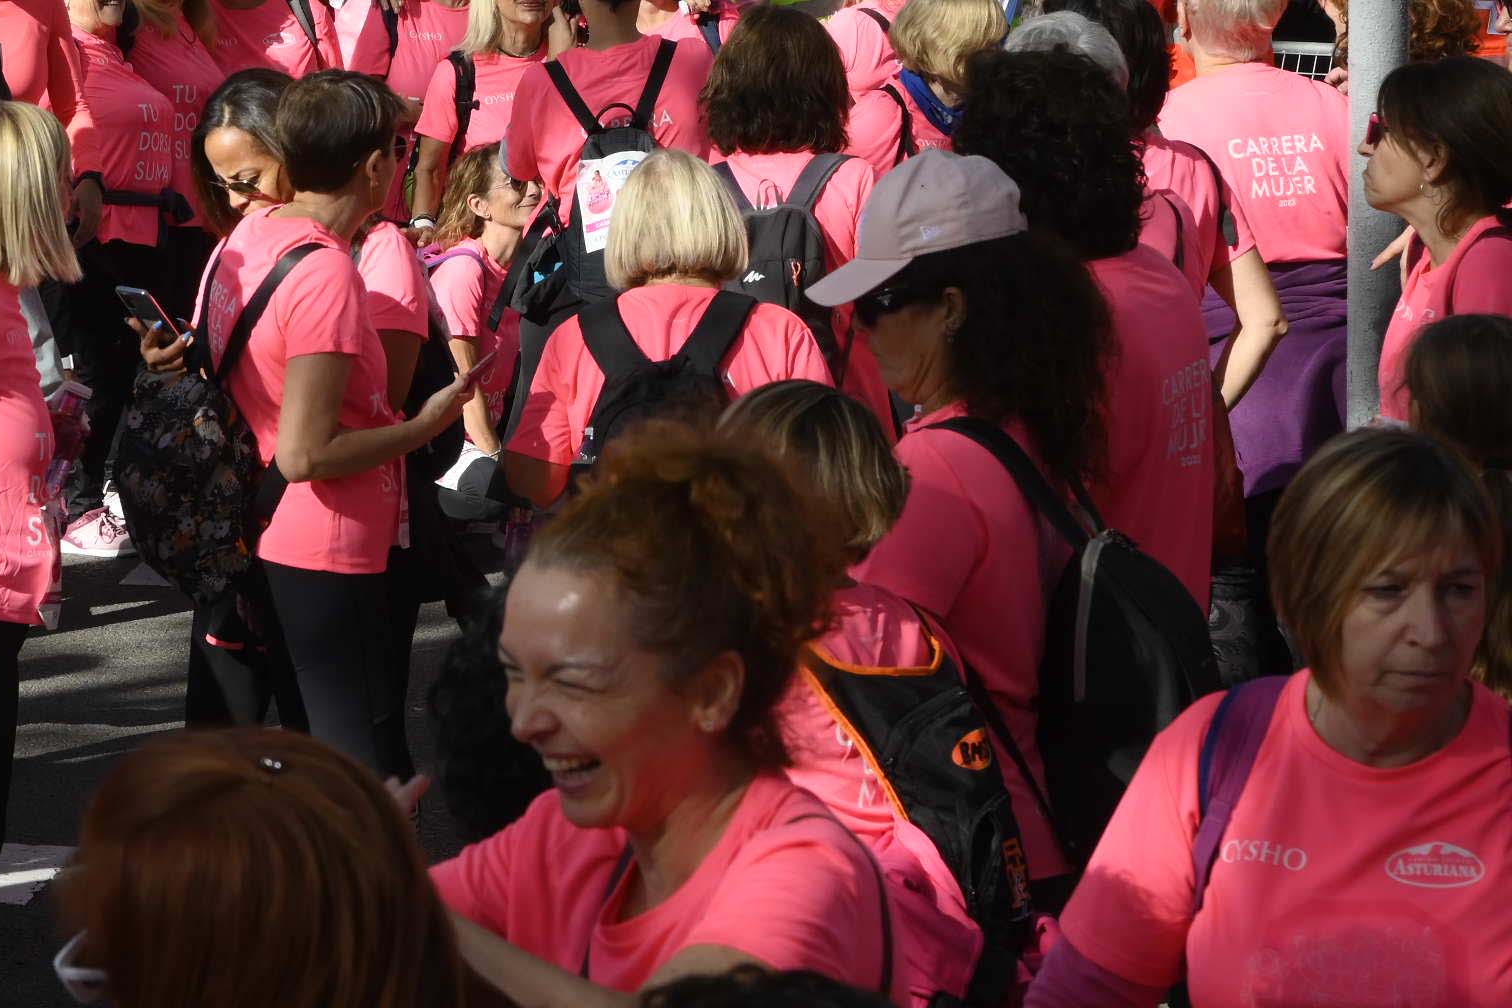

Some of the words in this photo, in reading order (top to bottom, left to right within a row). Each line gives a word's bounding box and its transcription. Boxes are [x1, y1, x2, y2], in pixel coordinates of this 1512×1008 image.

[409, 31, 442, 41] OYSHO
[172, 84, 197, 104] TU
[138, 103, 159, 123] TU
[1228, 132, 1325, 159] CARRERA
[135, 160, 169, 182] SUMA
[1251, 157, 1280, 177] DE
[1282, 156, 1309, 176] LA
[1251, 175, 1317, 200] MUJER
[1394, 858, 1477, 879] ASTURIANA
